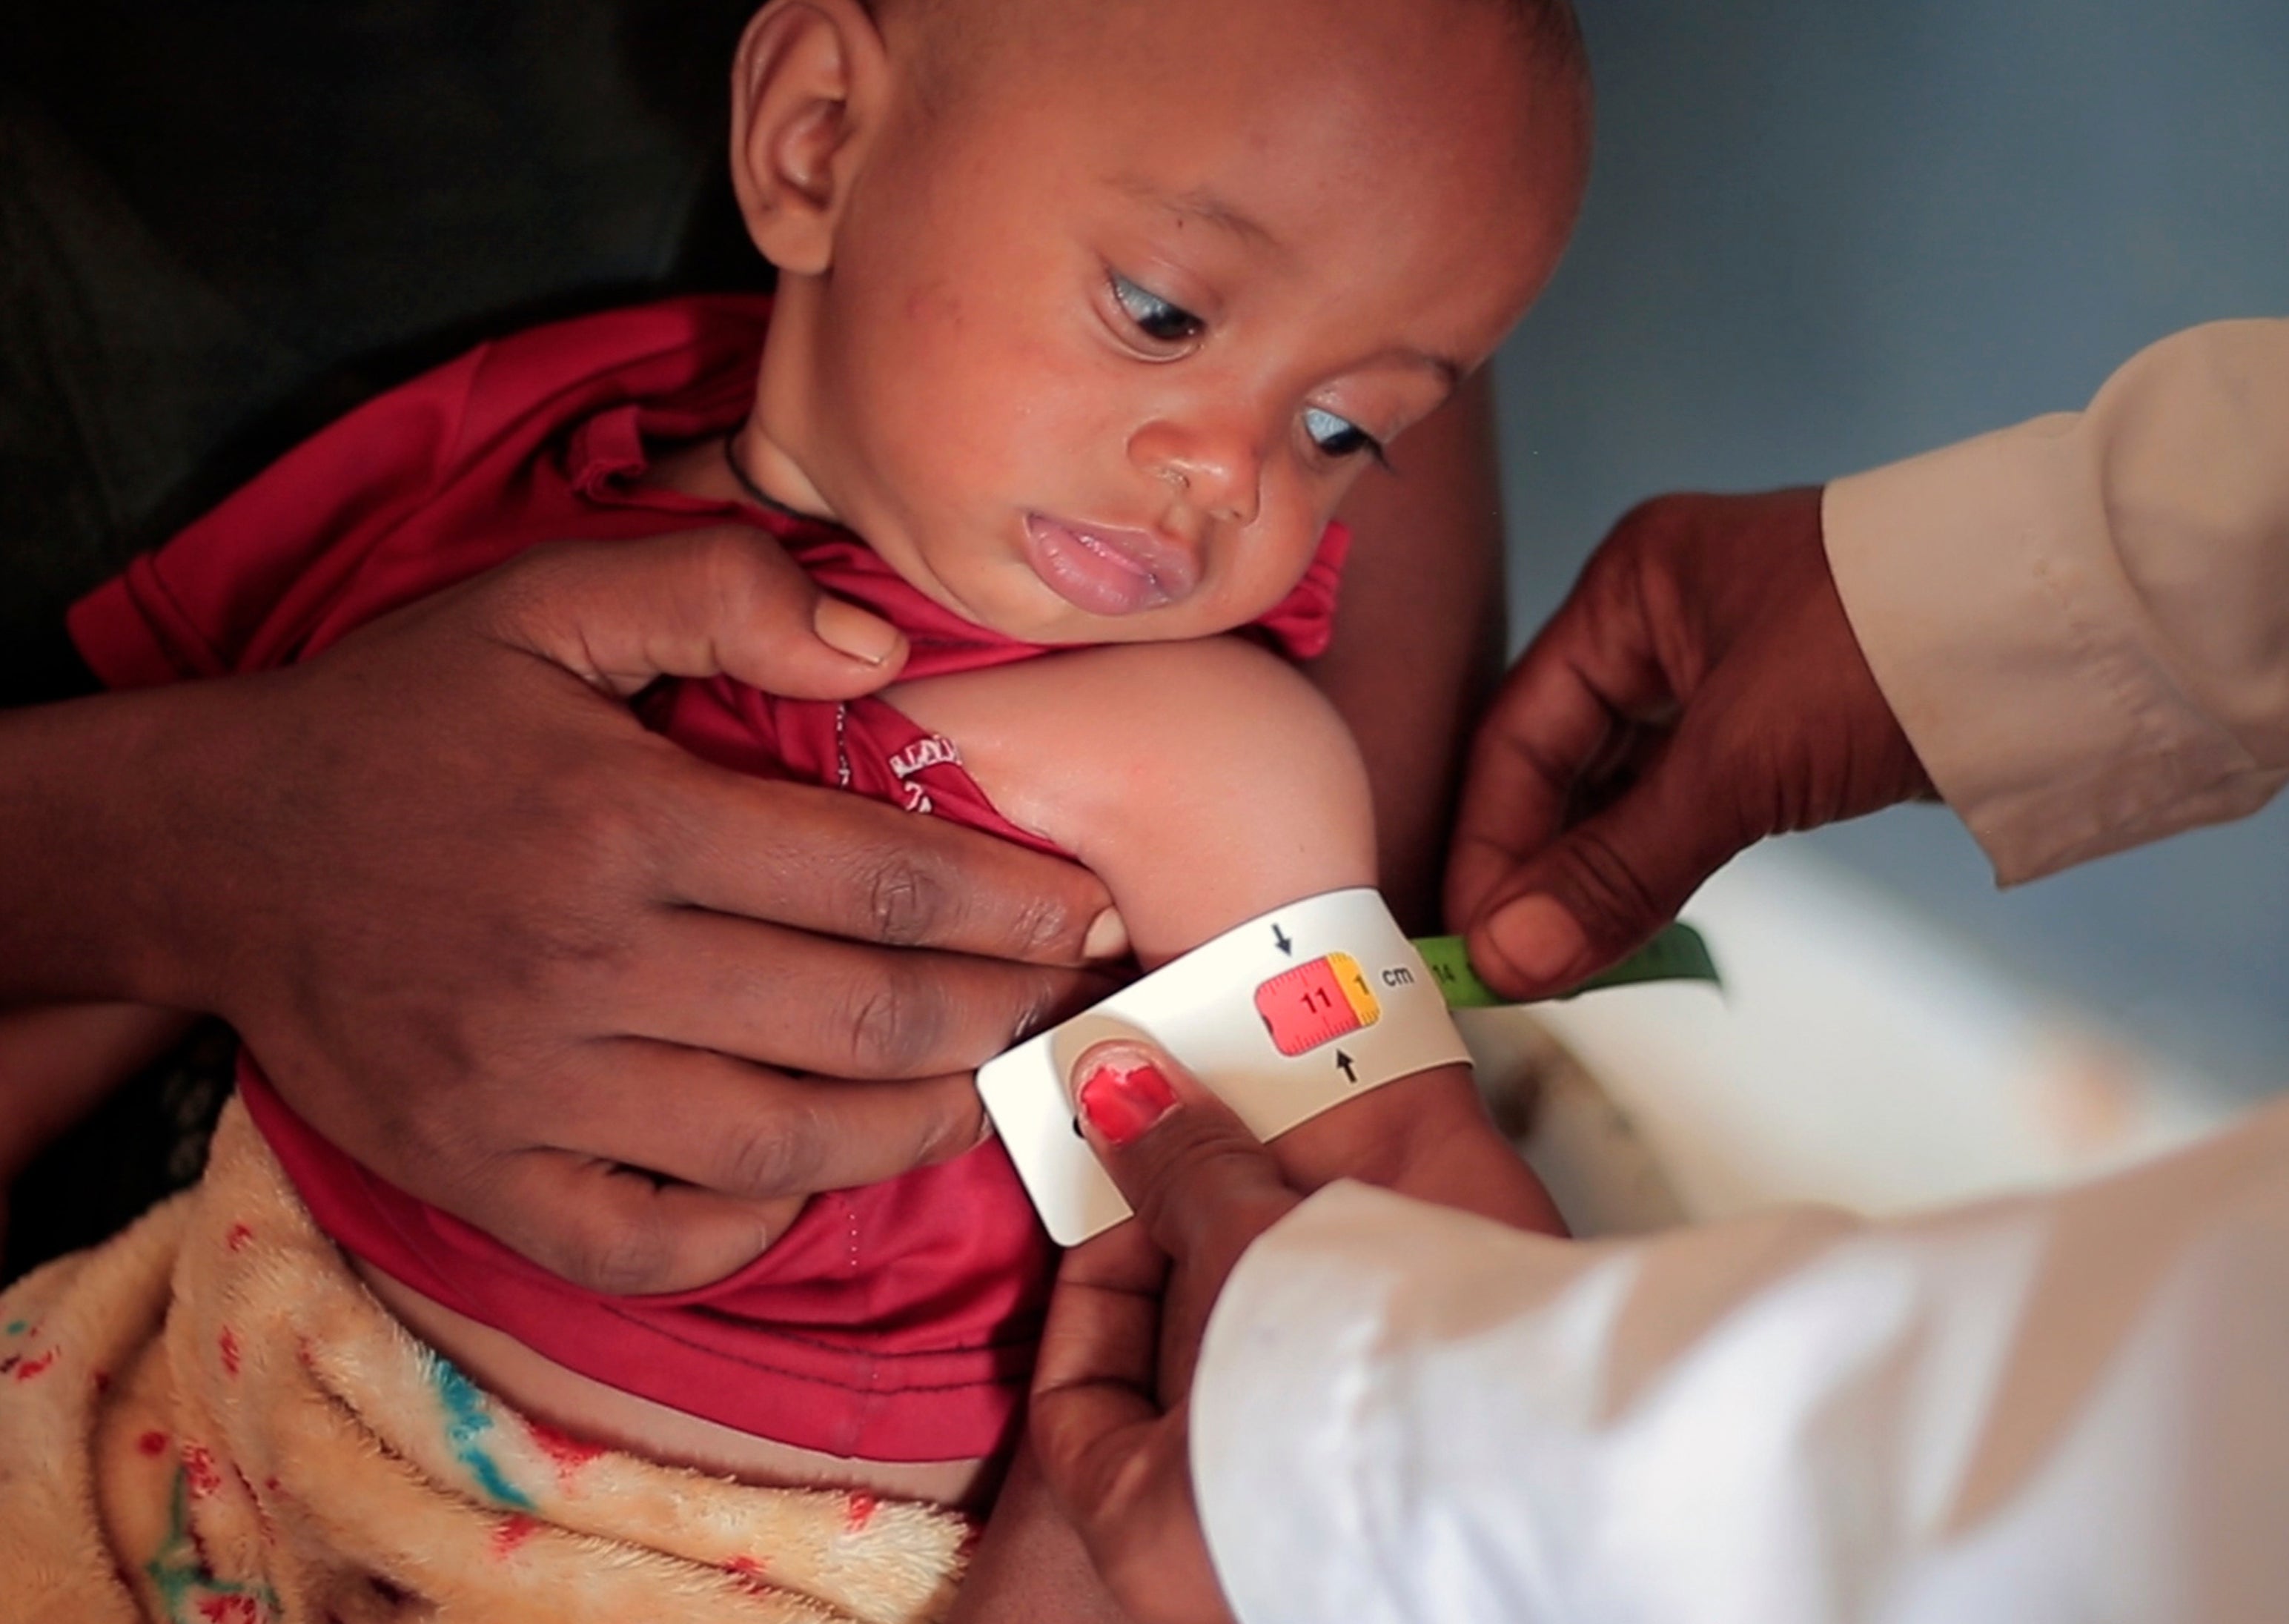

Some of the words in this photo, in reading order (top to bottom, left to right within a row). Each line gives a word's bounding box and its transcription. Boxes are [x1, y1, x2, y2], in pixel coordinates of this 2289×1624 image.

[1382, 967, 1414, 987] cm
[1432, 964, 1456, 984] 14
[1301, 987, 1331, 1013] 11
[1354, 975, 1371, 995] 1
